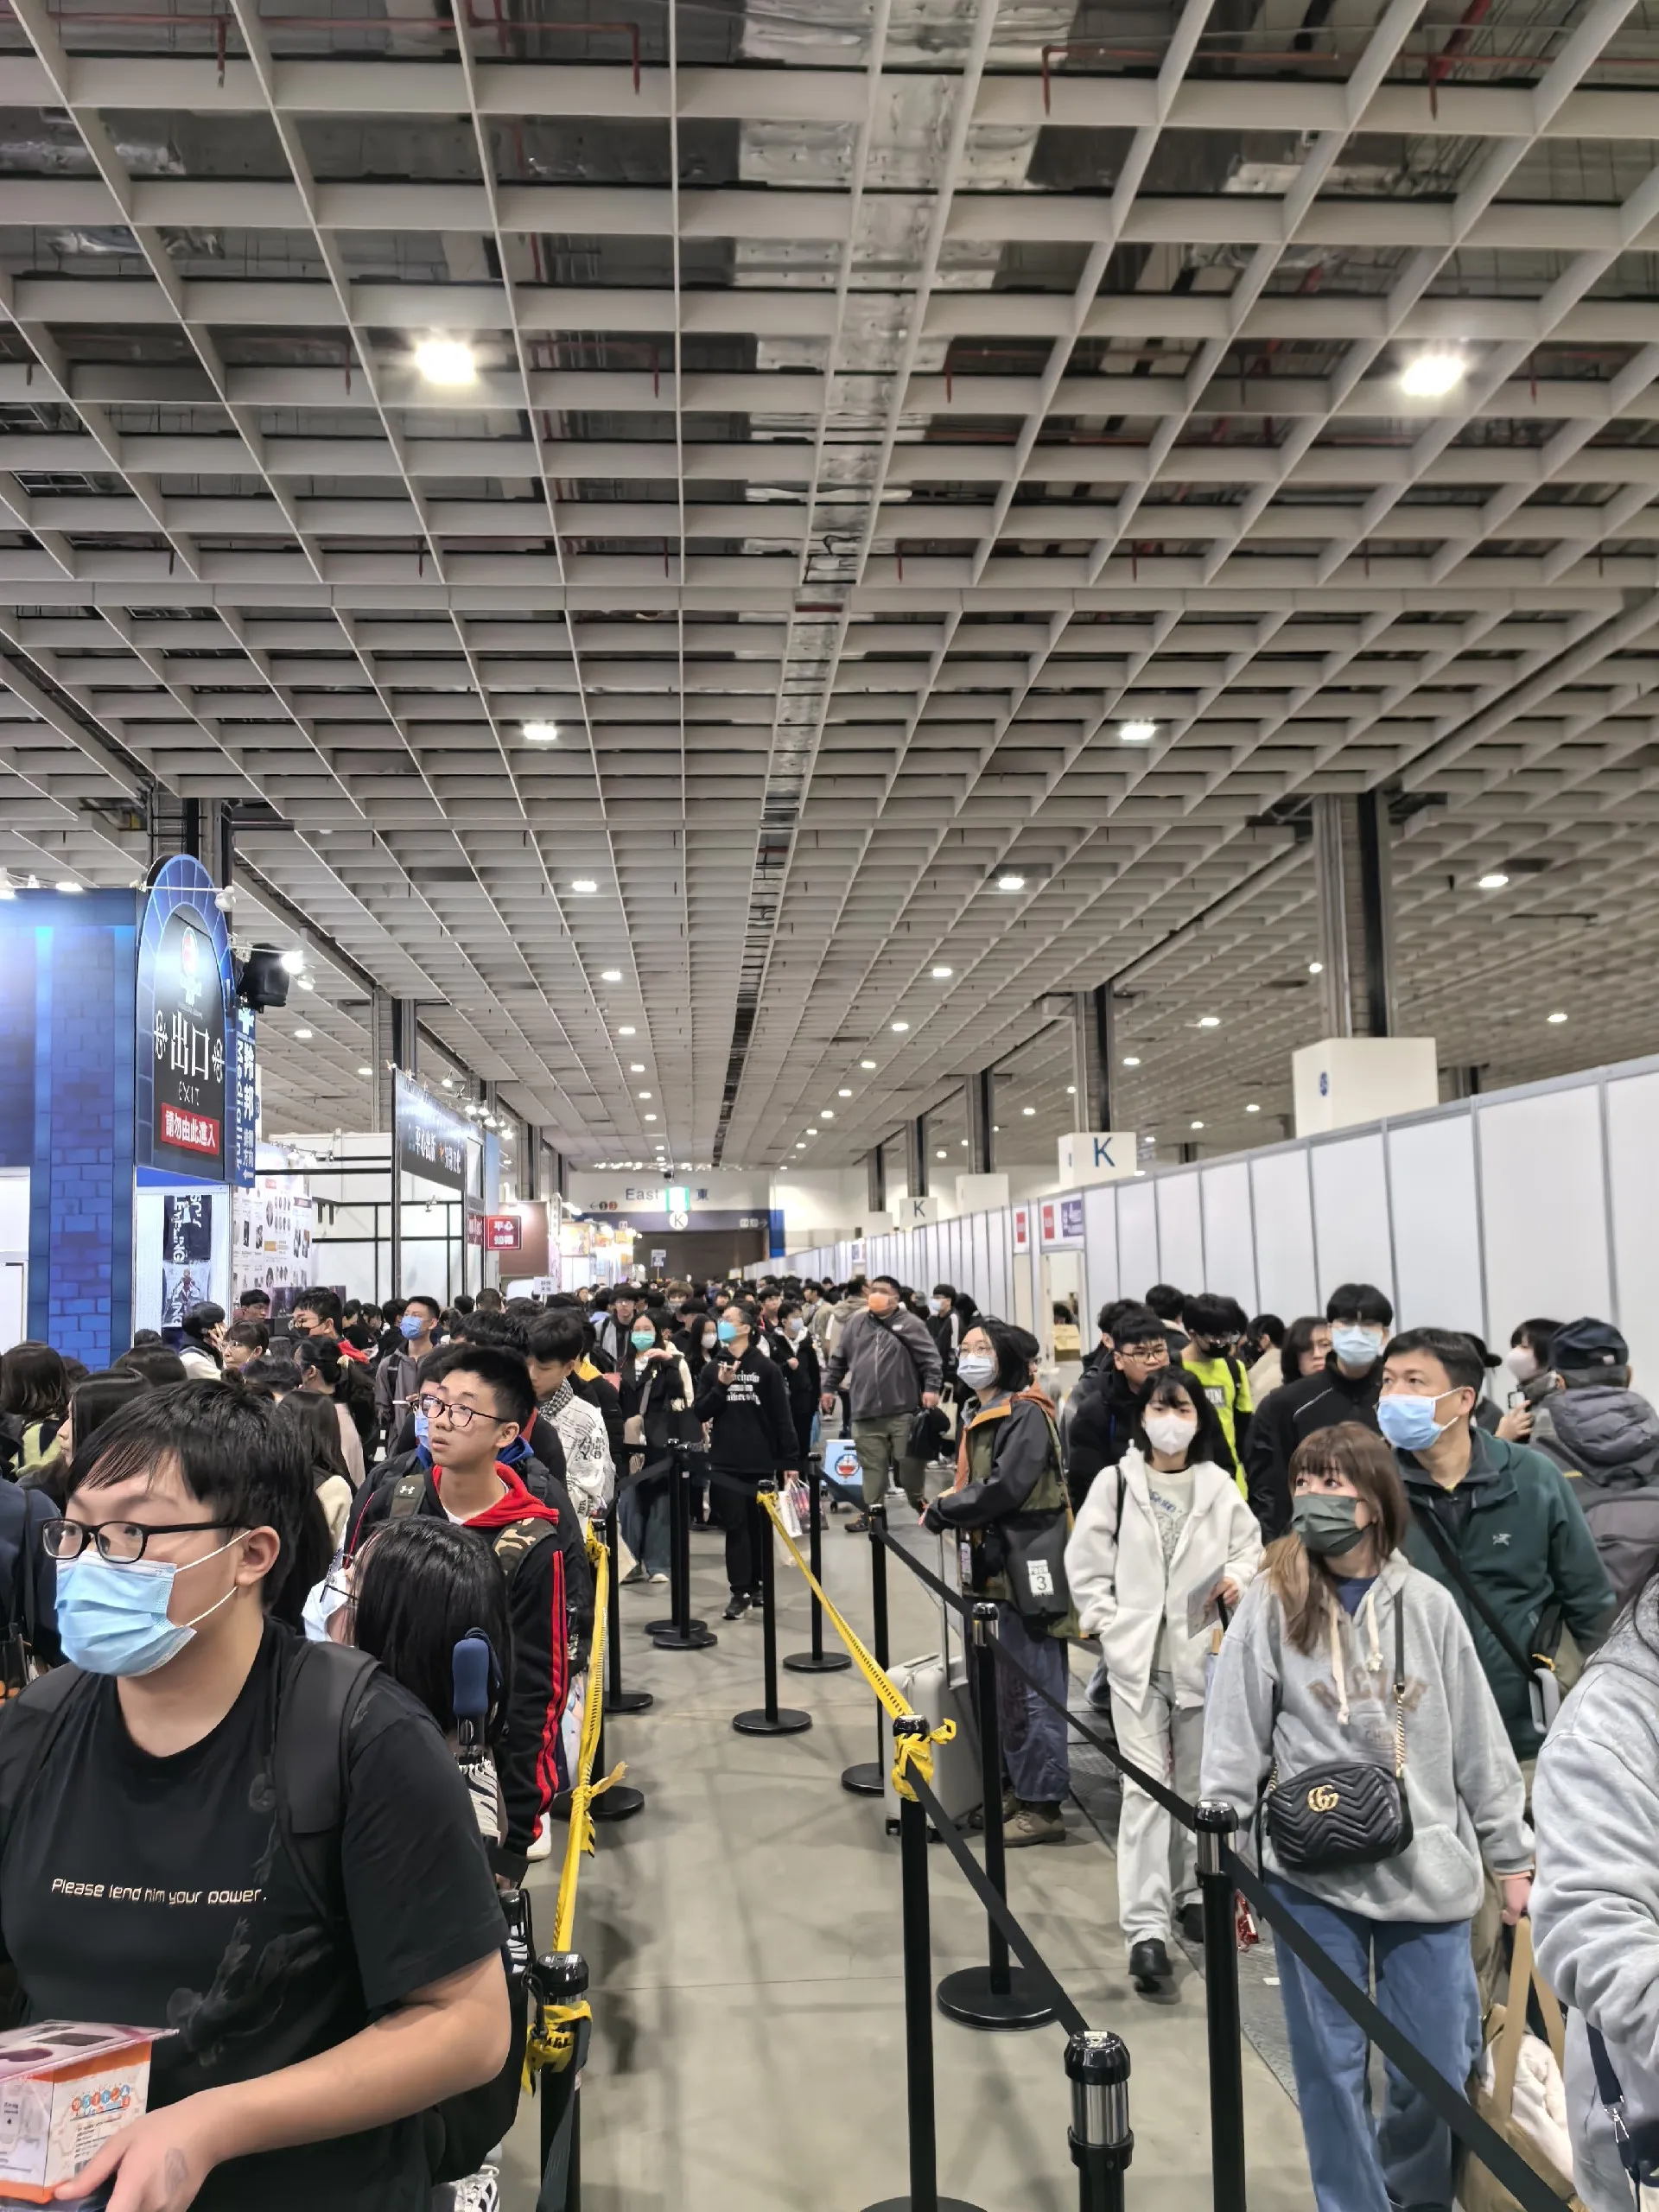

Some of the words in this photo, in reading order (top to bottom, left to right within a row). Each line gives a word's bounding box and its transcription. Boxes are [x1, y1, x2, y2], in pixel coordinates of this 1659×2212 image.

[171, 1009, 209, 1080] 出口
[178, 1080, 200, 1106] EXIT
[165, 1110, 216, 1148] 請勿由此進入
[1094, 1136, 1116, 1167] K
[626, 1188, 659, 1201] East
[674, 1214, 685, 1228] K
[914, 1200, 925, 1217] K
[1037, 1576, 1047, 1591] 3
[52, 1878, 105, 1897] Please
[109, 1885, 142, 1901] lend
[144, 1888, 165, 1902] him
[169, 1891, 203, 1904] your
[207, 1888, 267, 1904] power.
